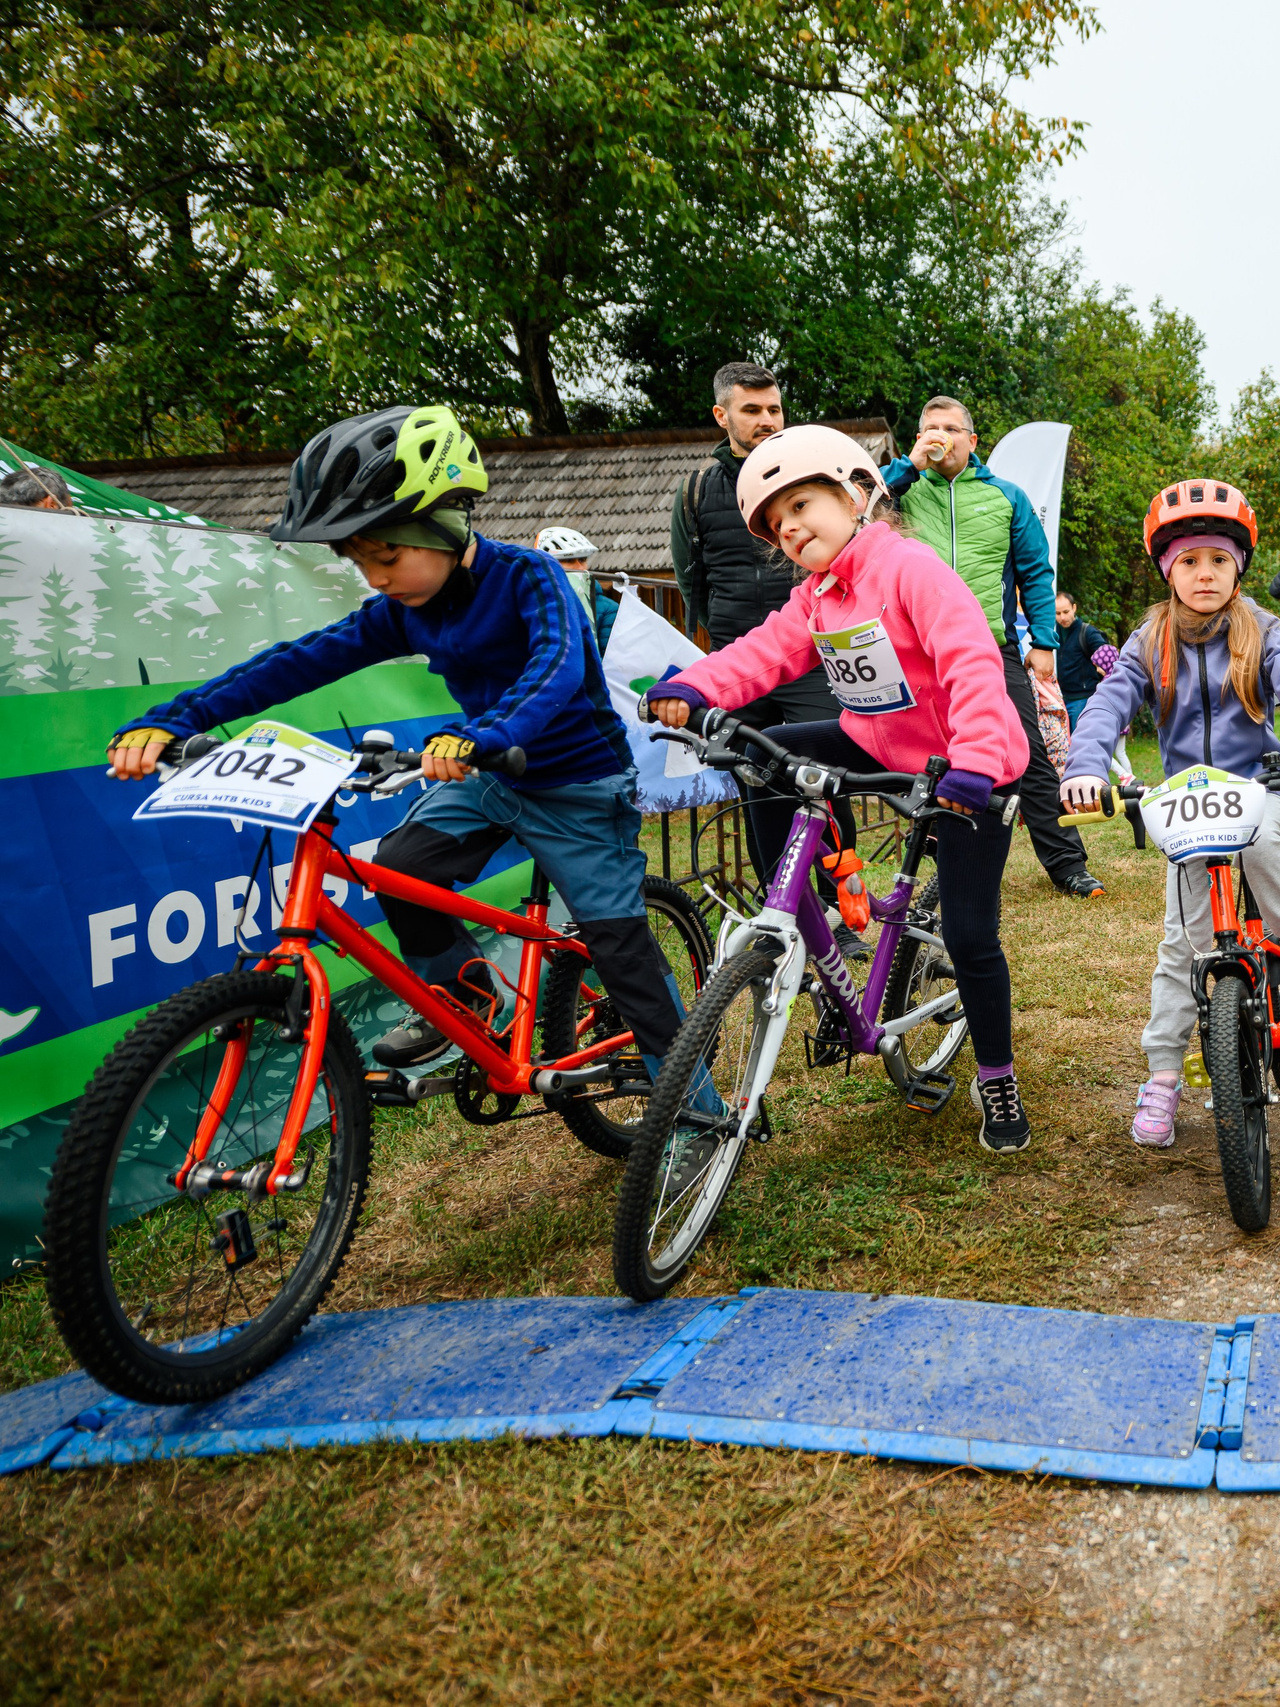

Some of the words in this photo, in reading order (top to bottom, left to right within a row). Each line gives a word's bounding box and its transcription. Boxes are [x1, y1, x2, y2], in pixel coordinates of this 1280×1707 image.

[823, 655, 877, 684] 086
[862, 695, 883, 704] KIDS
[190, 749, 306, 787] 7042
[173, 793, 208, 802] CURSA
[211, 795, 238, 803] MTB
[241, 797, 272, 809] KIDS
[1160, 790, 1243, 828] 7068
[1169, 837, 1193, 850] CURSA
[1196, 834, 1215, 842] MTB
[1218, 834, 1238, 842] KIDS
[343, 1182, 358, 1225] BTWIN
